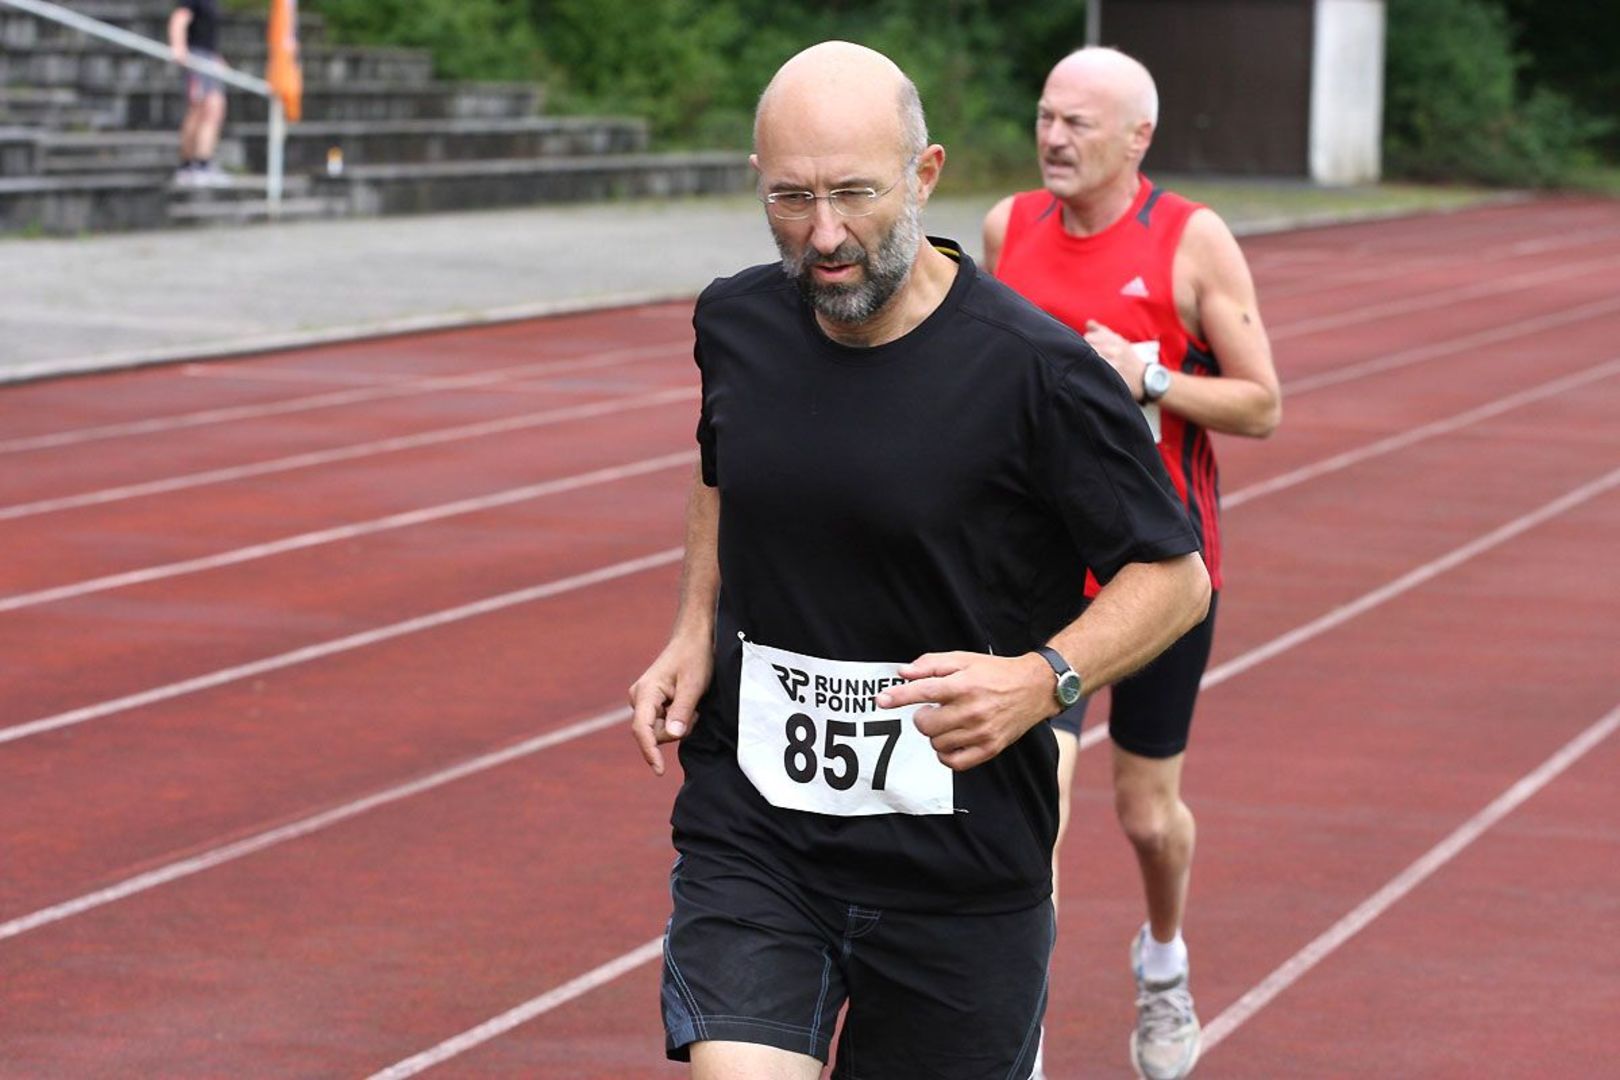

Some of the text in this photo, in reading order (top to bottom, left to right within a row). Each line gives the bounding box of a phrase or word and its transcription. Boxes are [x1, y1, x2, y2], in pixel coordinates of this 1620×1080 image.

[815, 674, 911, 695] RUNNE
[815, 692, 877, 713] POINT
[784, 713, 902, 791] 857
